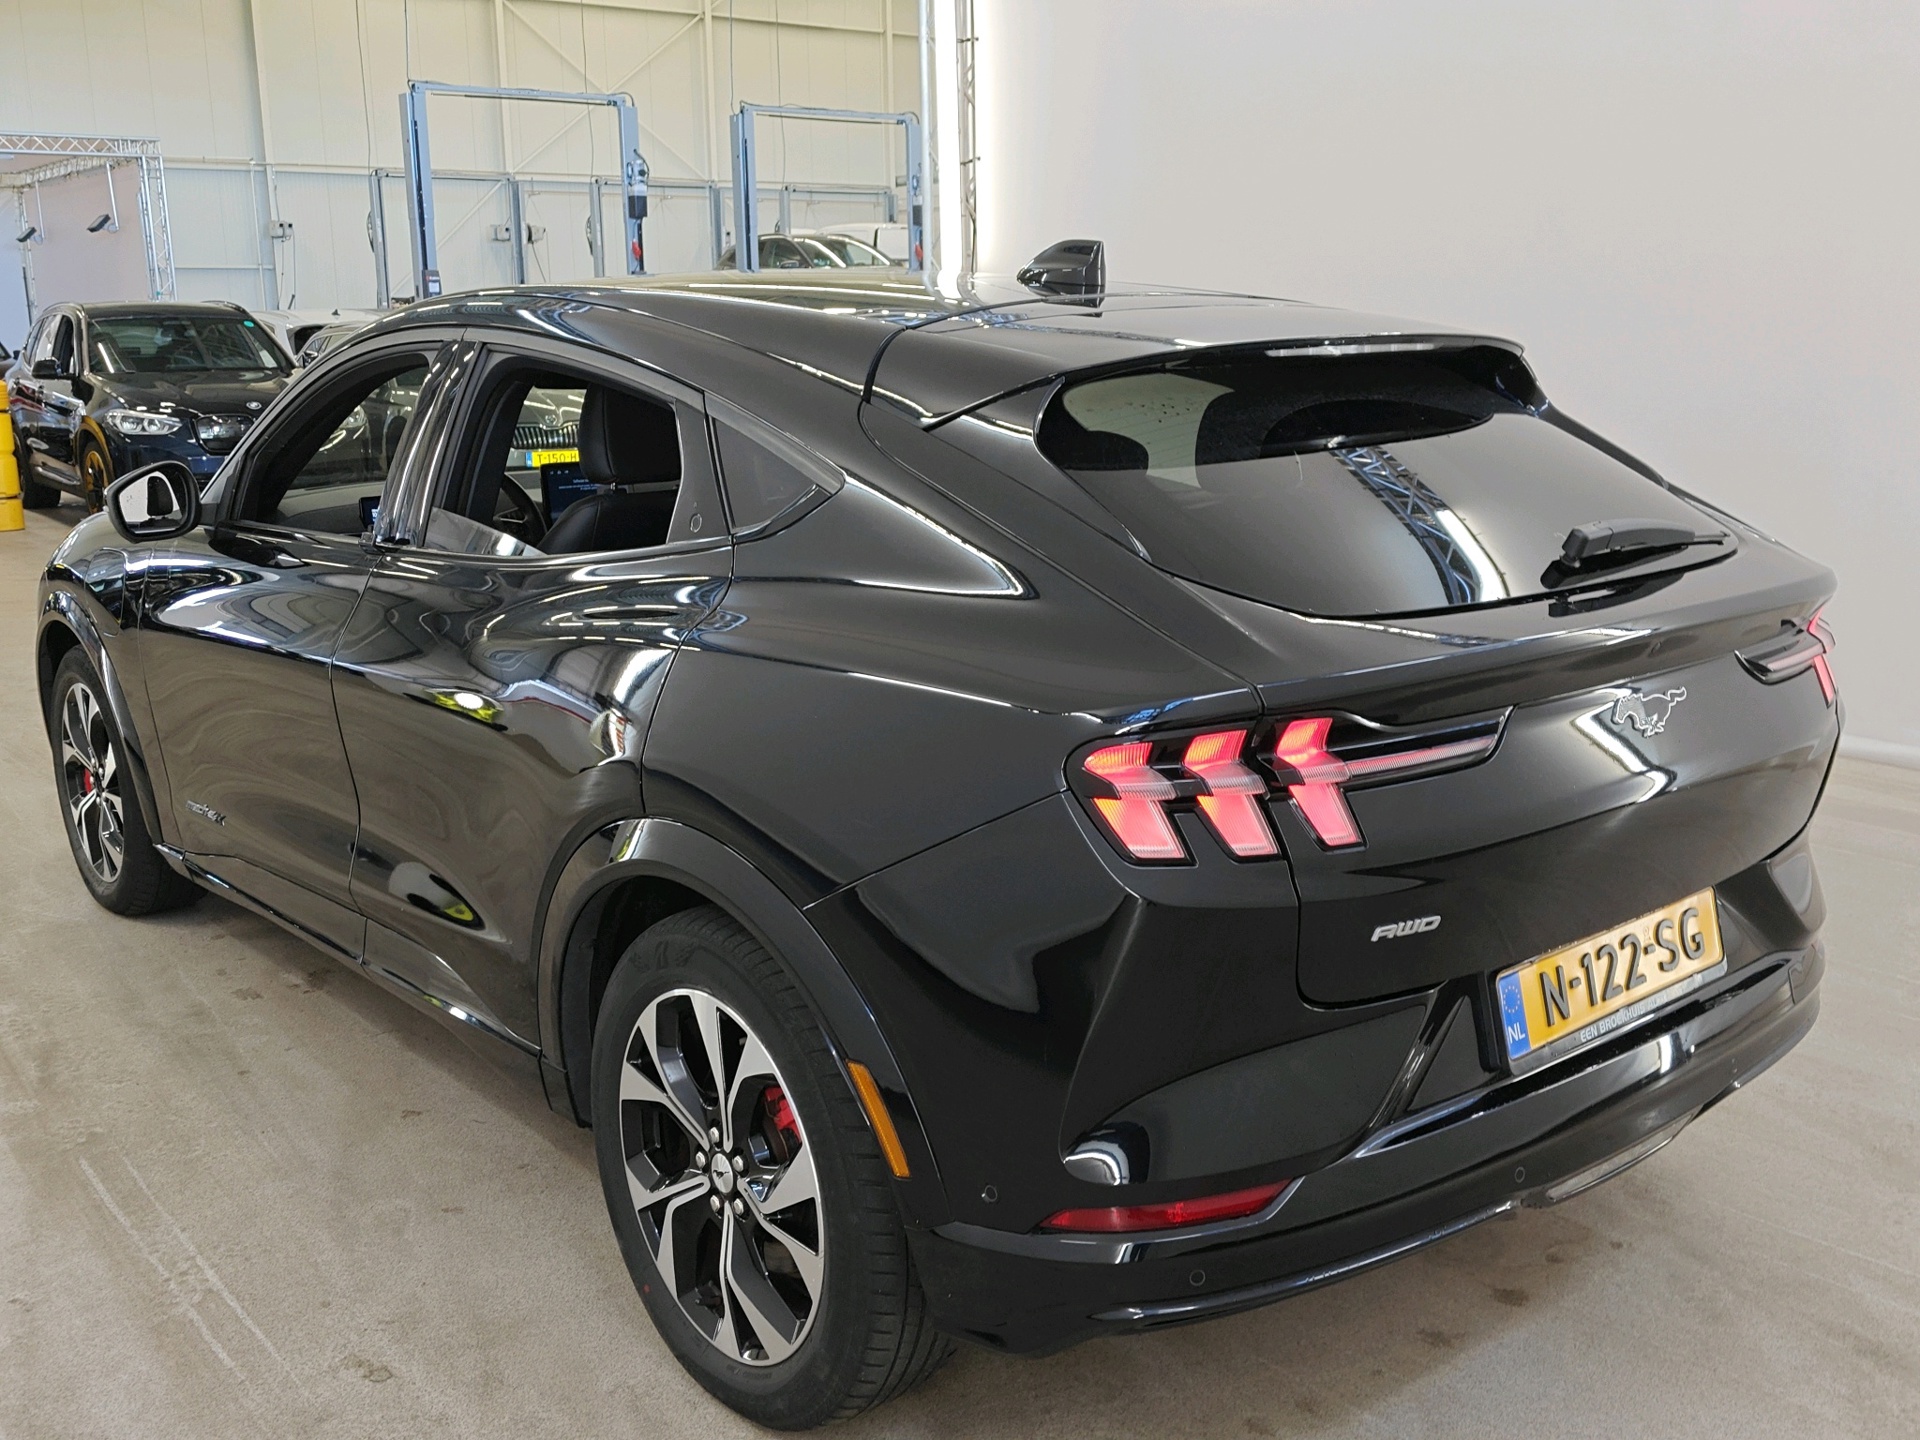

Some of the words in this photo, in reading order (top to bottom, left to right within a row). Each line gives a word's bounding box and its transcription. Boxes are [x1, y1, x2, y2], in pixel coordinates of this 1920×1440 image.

[1371, 915, 1442, 942] AWD
[1539, 907, 1706, 1028] N-122-SG
[1507, 1022, 1526, 1044] NL
[1580, 1023, 1598, 1043] EEN
